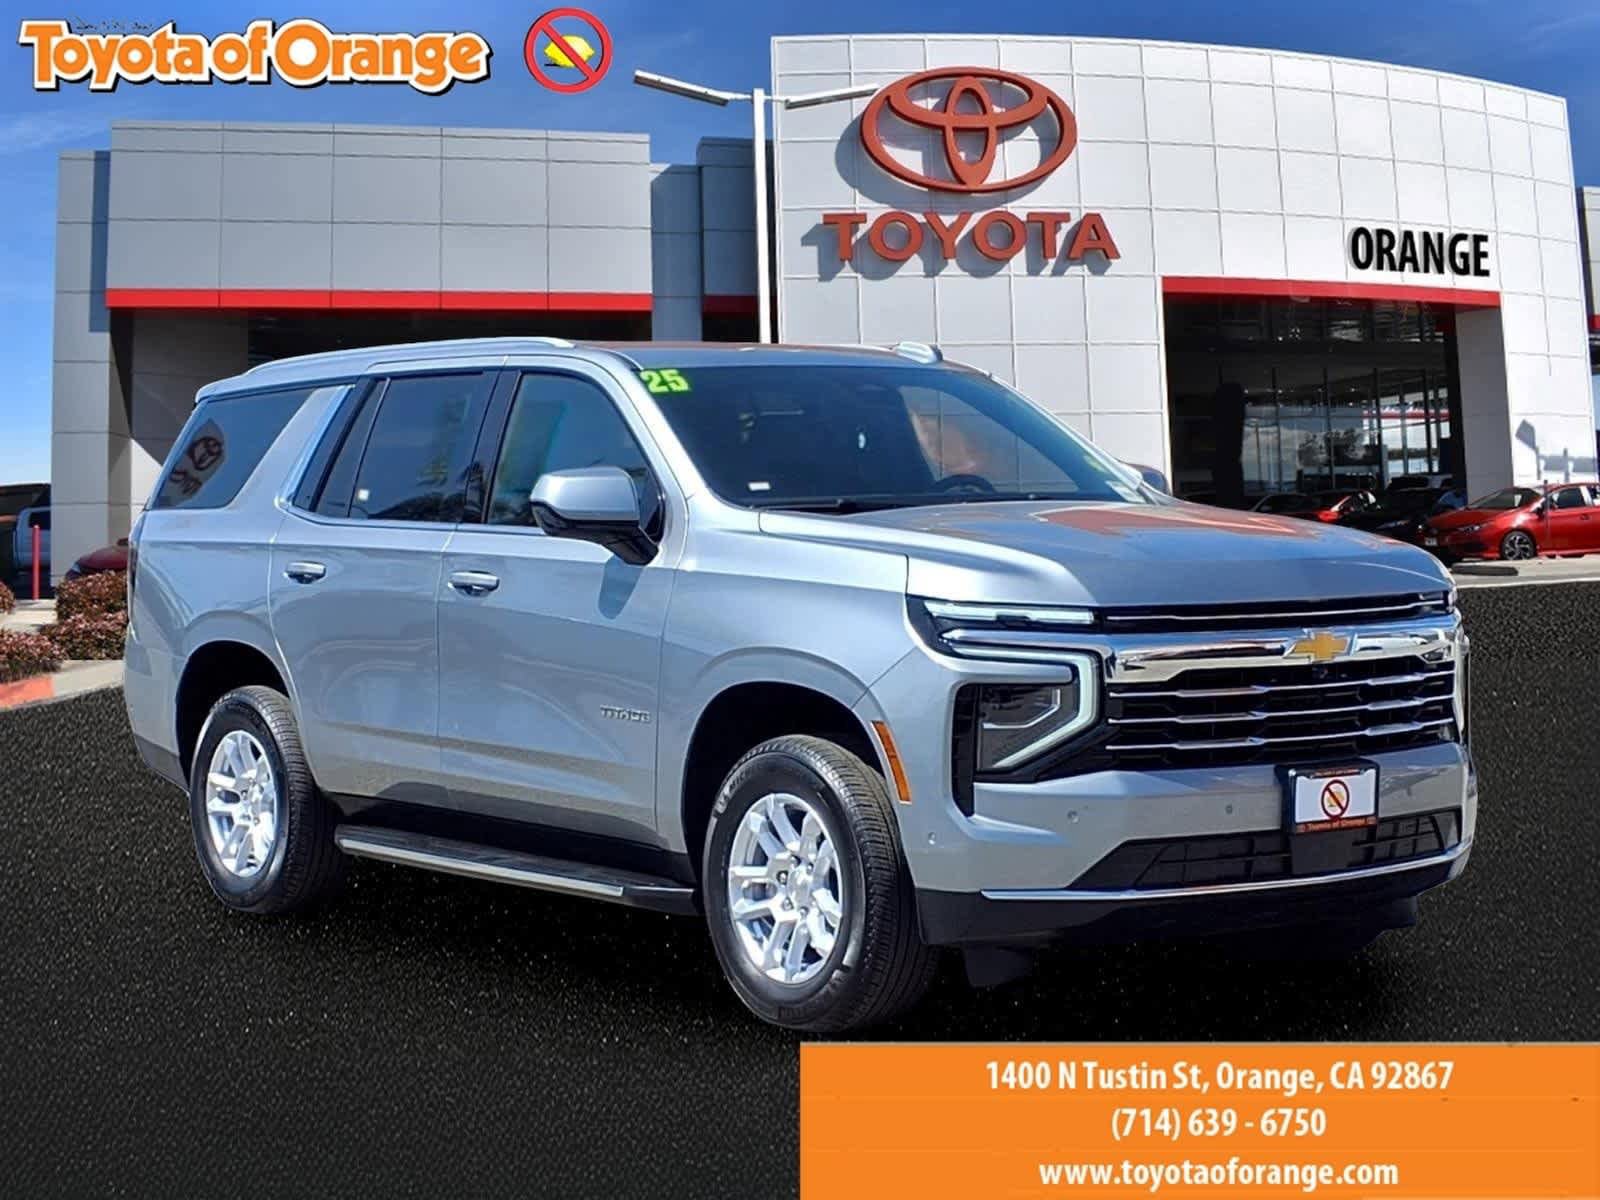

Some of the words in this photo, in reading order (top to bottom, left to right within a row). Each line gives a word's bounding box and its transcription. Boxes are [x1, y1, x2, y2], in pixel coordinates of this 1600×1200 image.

[823, 210, 1119, 262] TOYOTA
[1350, 227, 1489, 276] ORANGE
[640, 368, 690, 393] 25
